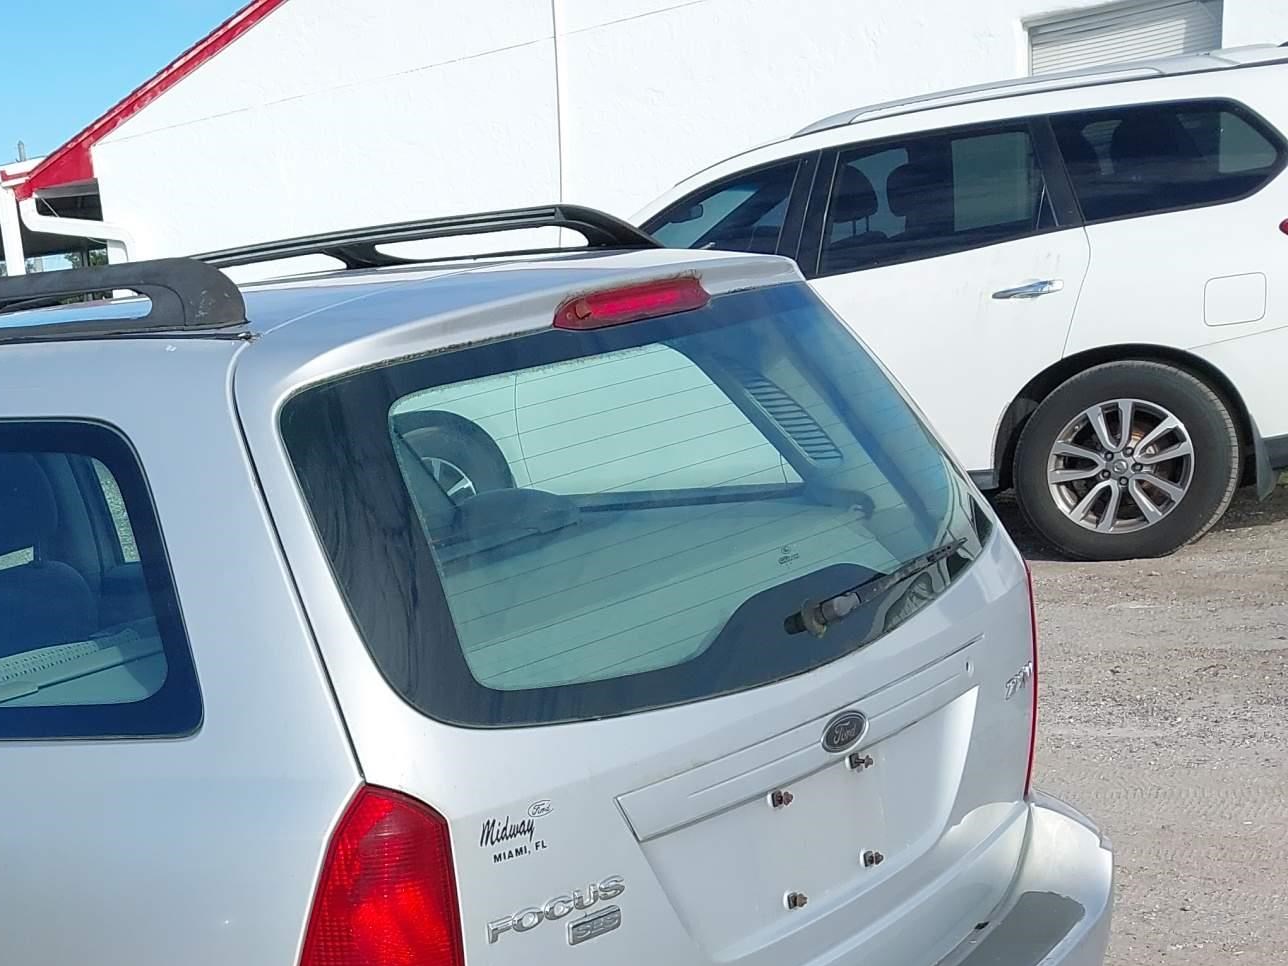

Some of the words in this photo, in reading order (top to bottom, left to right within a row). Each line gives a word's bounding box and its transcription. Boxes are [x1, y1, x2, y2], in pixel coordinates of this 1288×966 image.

[530, 802, 552, 816] Ford
[479, 815, 535, 848] Midway
[493, 845, 531, 863] MIAMI,
[535, 840, 548, 851] FL
[486, 875, 626, 944] FOCUS
[575, 913, 619, 941] SES
